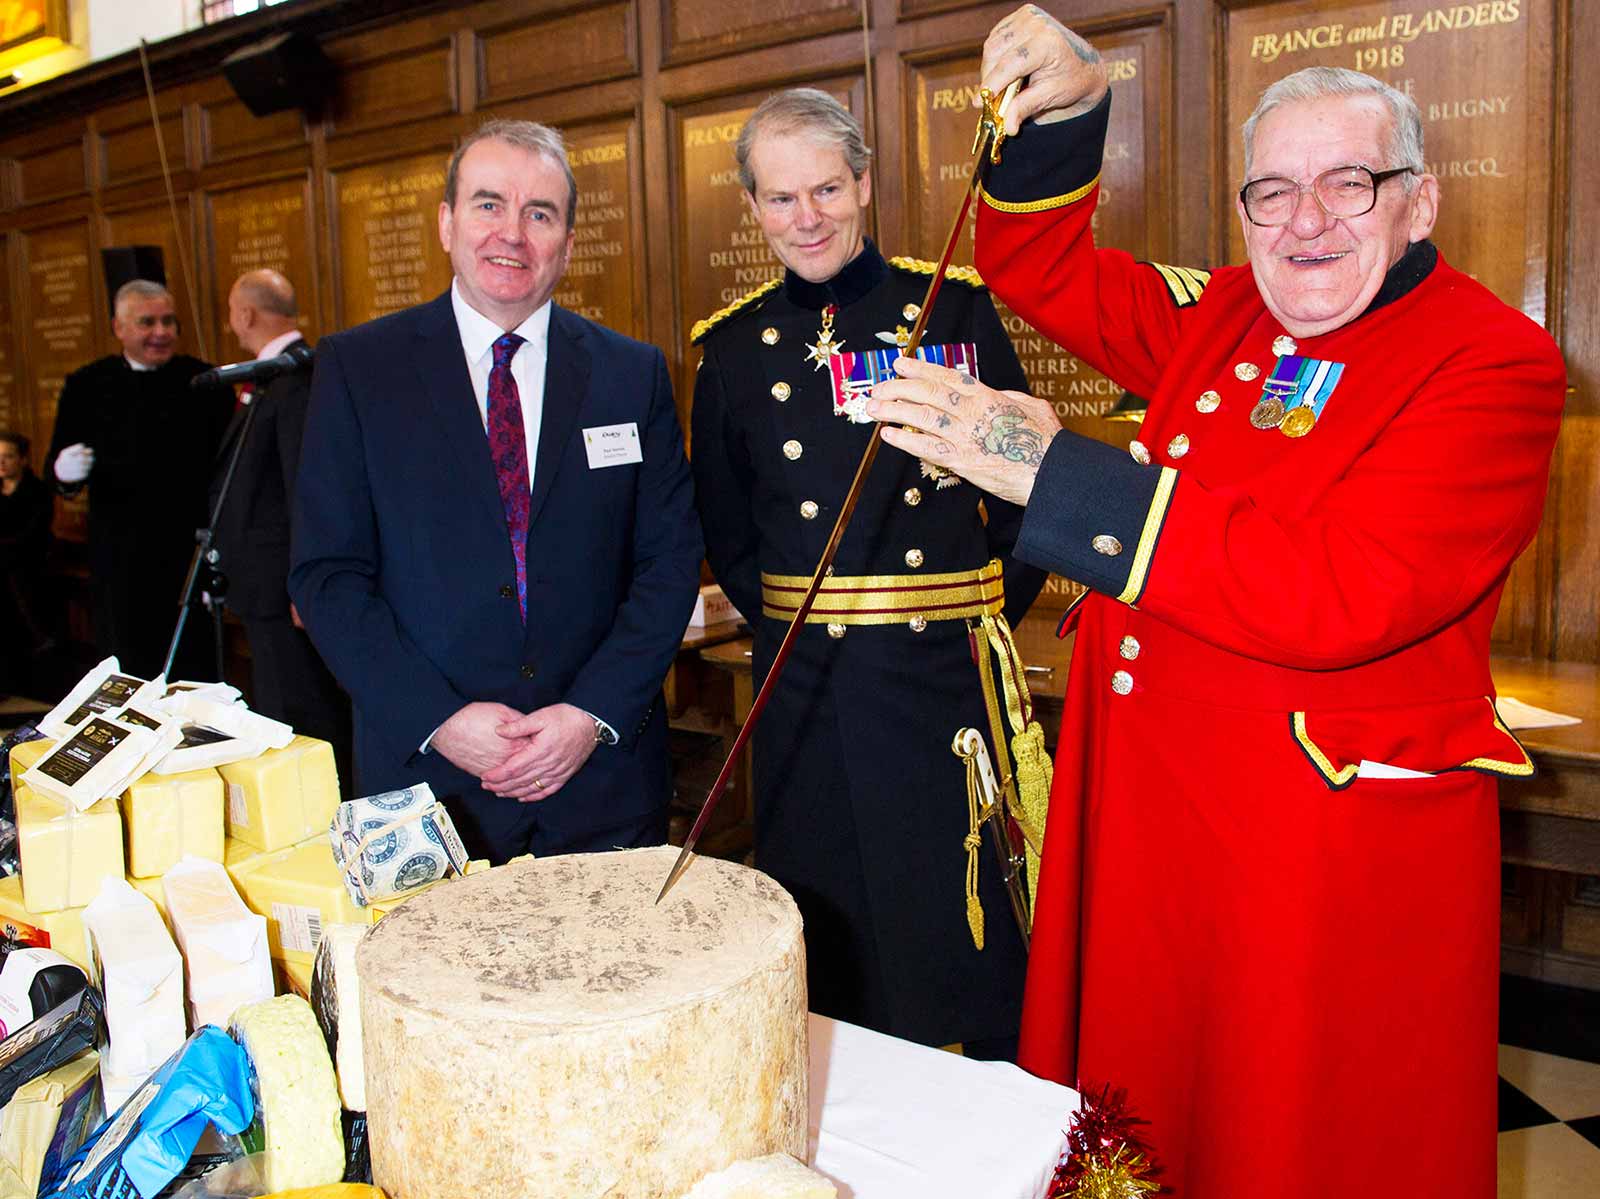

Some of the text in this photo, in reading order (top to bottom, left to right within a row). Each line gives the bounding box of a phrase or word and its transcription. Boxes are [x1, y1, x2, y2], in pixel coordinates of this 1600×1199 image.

[1250, 0, 1521, 62] FRANCE and FLANDERS
[1354, 45, 1405, 71] 1918
[933, 84, 979, 113] FRAN
[1428, 95, 1511, 122] BLIGNY
[940, 162, 973, 182] PILC
[1011, 338, 1042, 354] TIN
[1021, 356, 1078, 376] SIERES
[1068, 377, 1126, 396] ANCR
